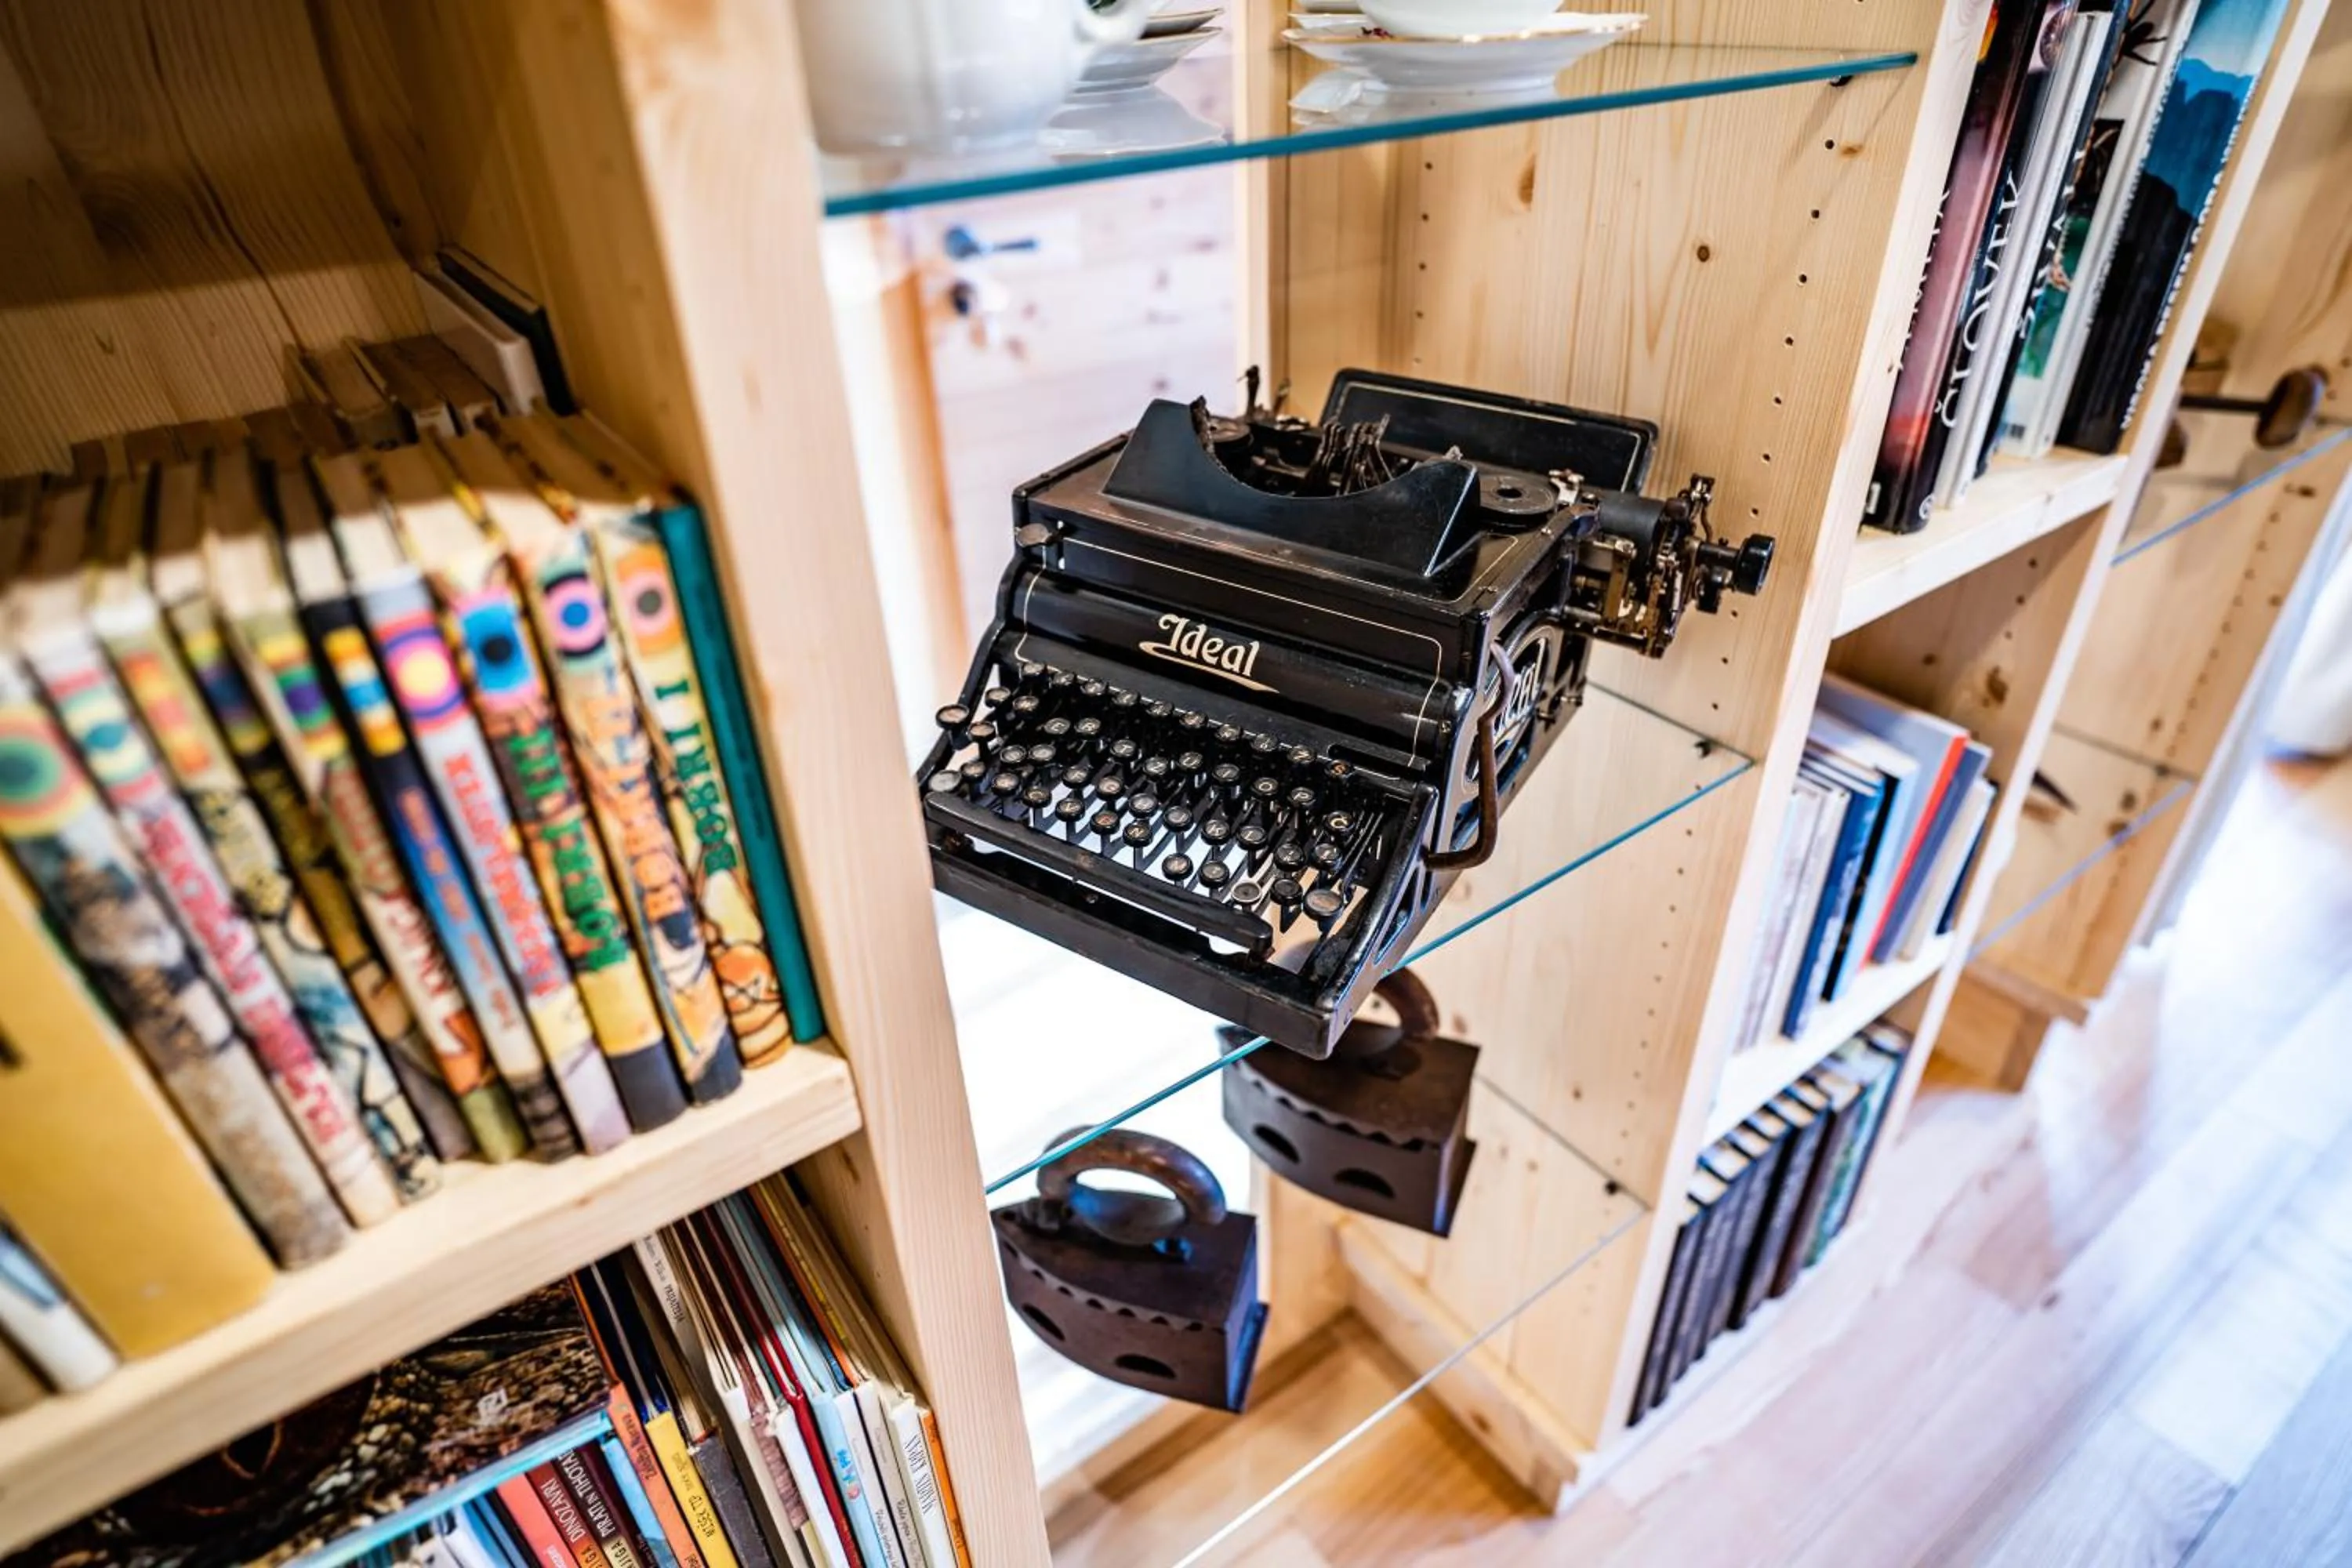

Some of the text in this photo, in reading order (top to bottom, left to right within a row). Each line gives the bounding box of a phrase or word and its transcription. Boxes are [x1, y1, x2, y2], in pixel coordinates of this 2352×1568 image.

[1145, 614, 1264, 681] Ideal
[664, 721, 738, 877] BOBRI
[540, 1477, 586, 1544] DINOZAVRI
[587, 1501, 616, 1538] PIRATI
